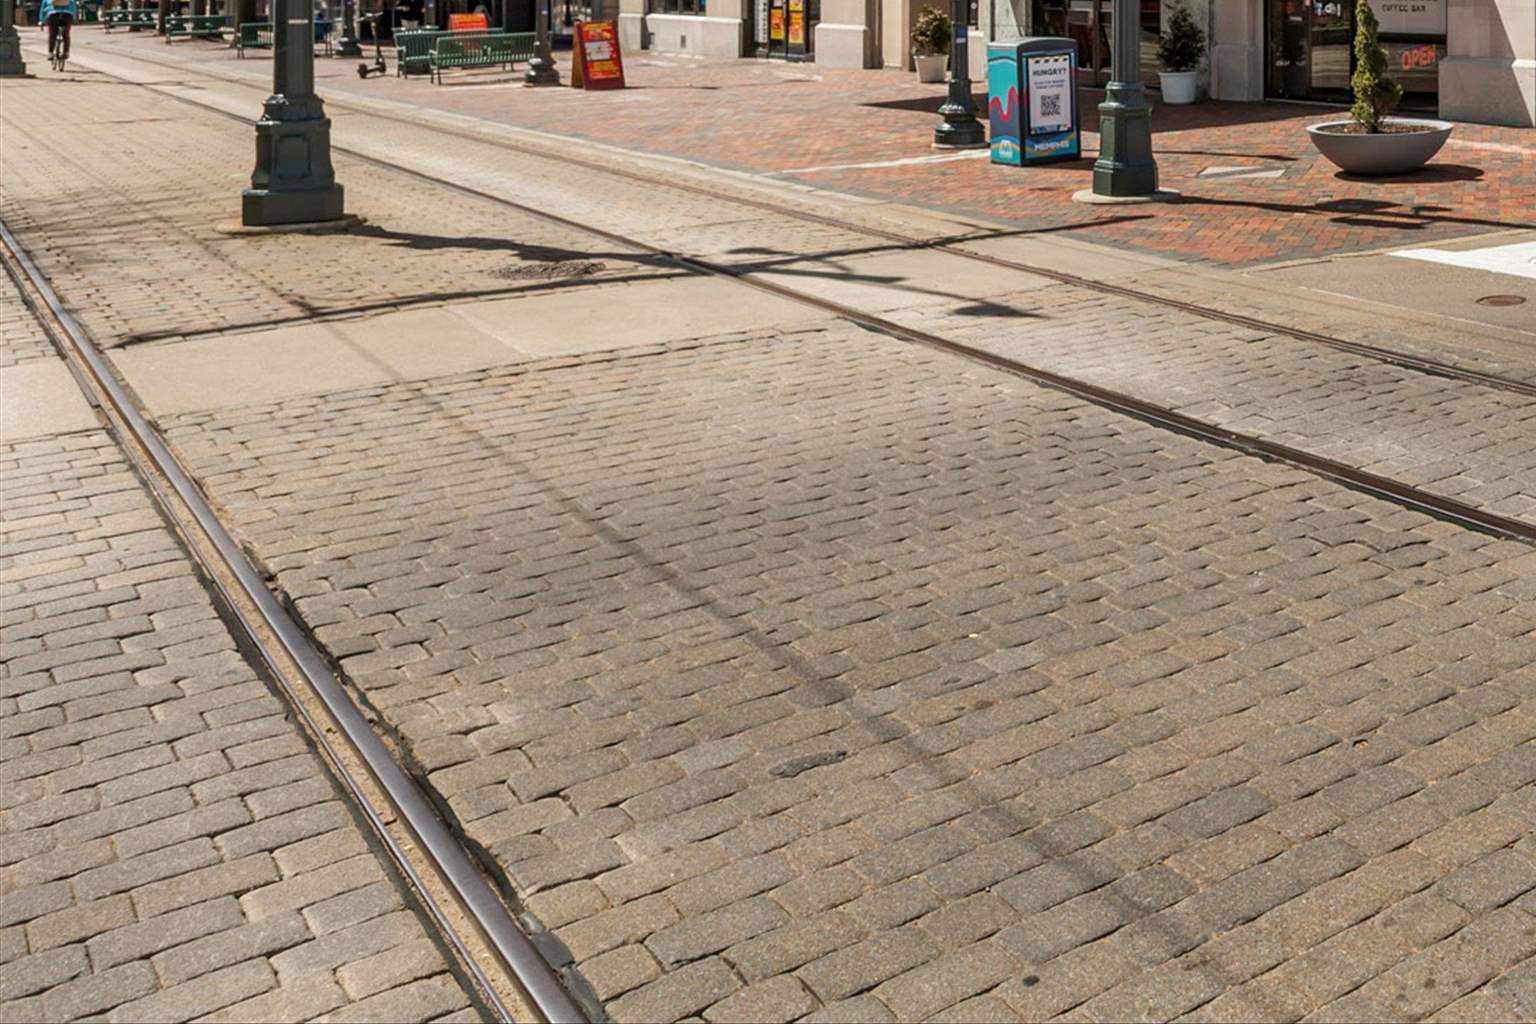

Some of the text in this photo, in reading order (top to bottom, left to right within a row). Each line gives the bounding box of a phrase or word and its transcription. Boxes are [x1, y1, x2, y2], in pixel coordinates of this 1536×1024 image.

[1382, 4, 1426, 12] COFFEE BAR
[1401, 44, 1436, 71] OPEN
[1033, 68, 1067, 76] HUNGRY?
